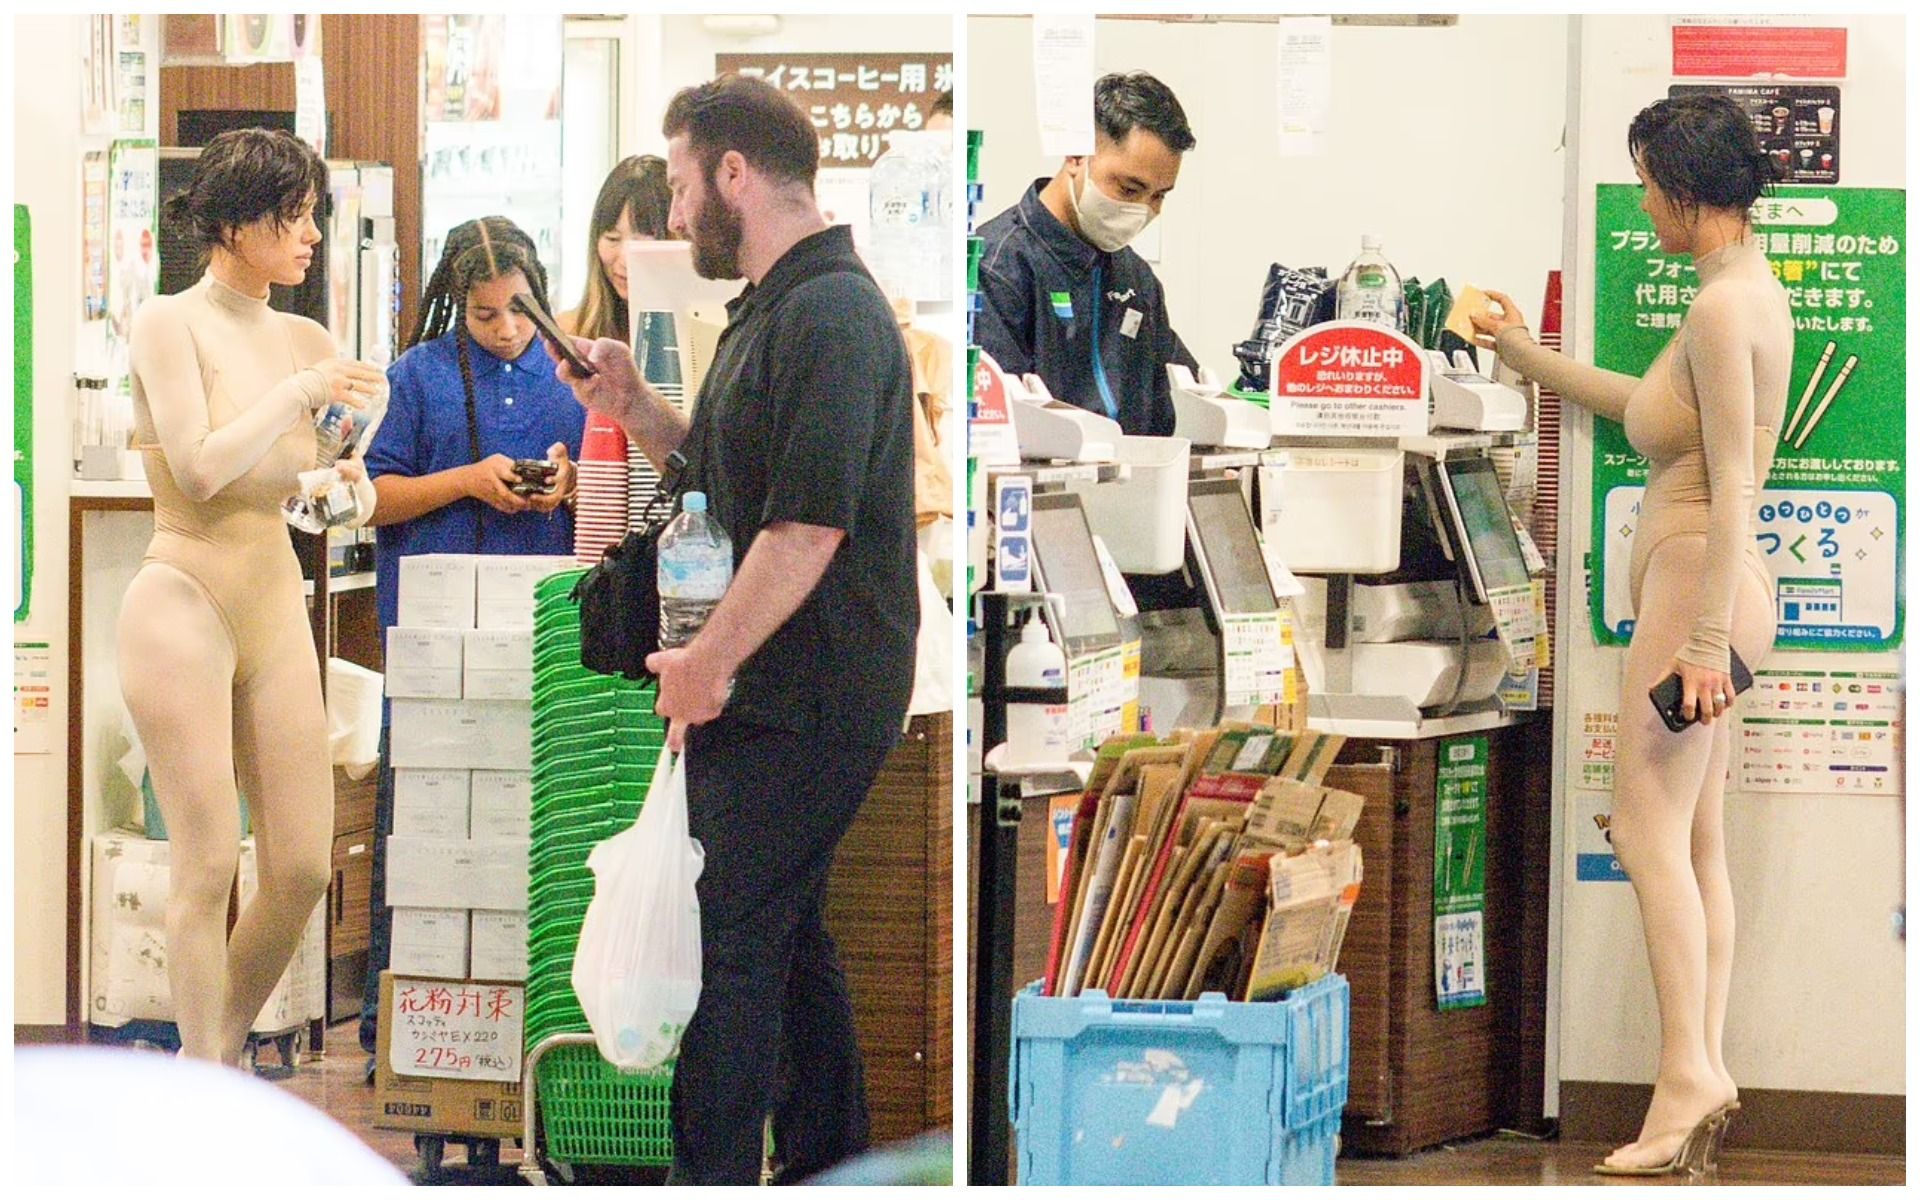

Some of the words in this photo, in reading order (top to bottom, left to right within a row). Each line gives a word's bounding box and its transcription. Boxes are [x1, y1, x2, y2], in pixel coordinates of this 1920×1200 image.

[810, 102, 922, 129] こちらから
[1300, 345, 1404, 369] レジ休止中
[1291, 401, 1318, 409] Please
[1321, 403, 1332, 411] go
[400, 985, 512, 1023] 花粉対策
